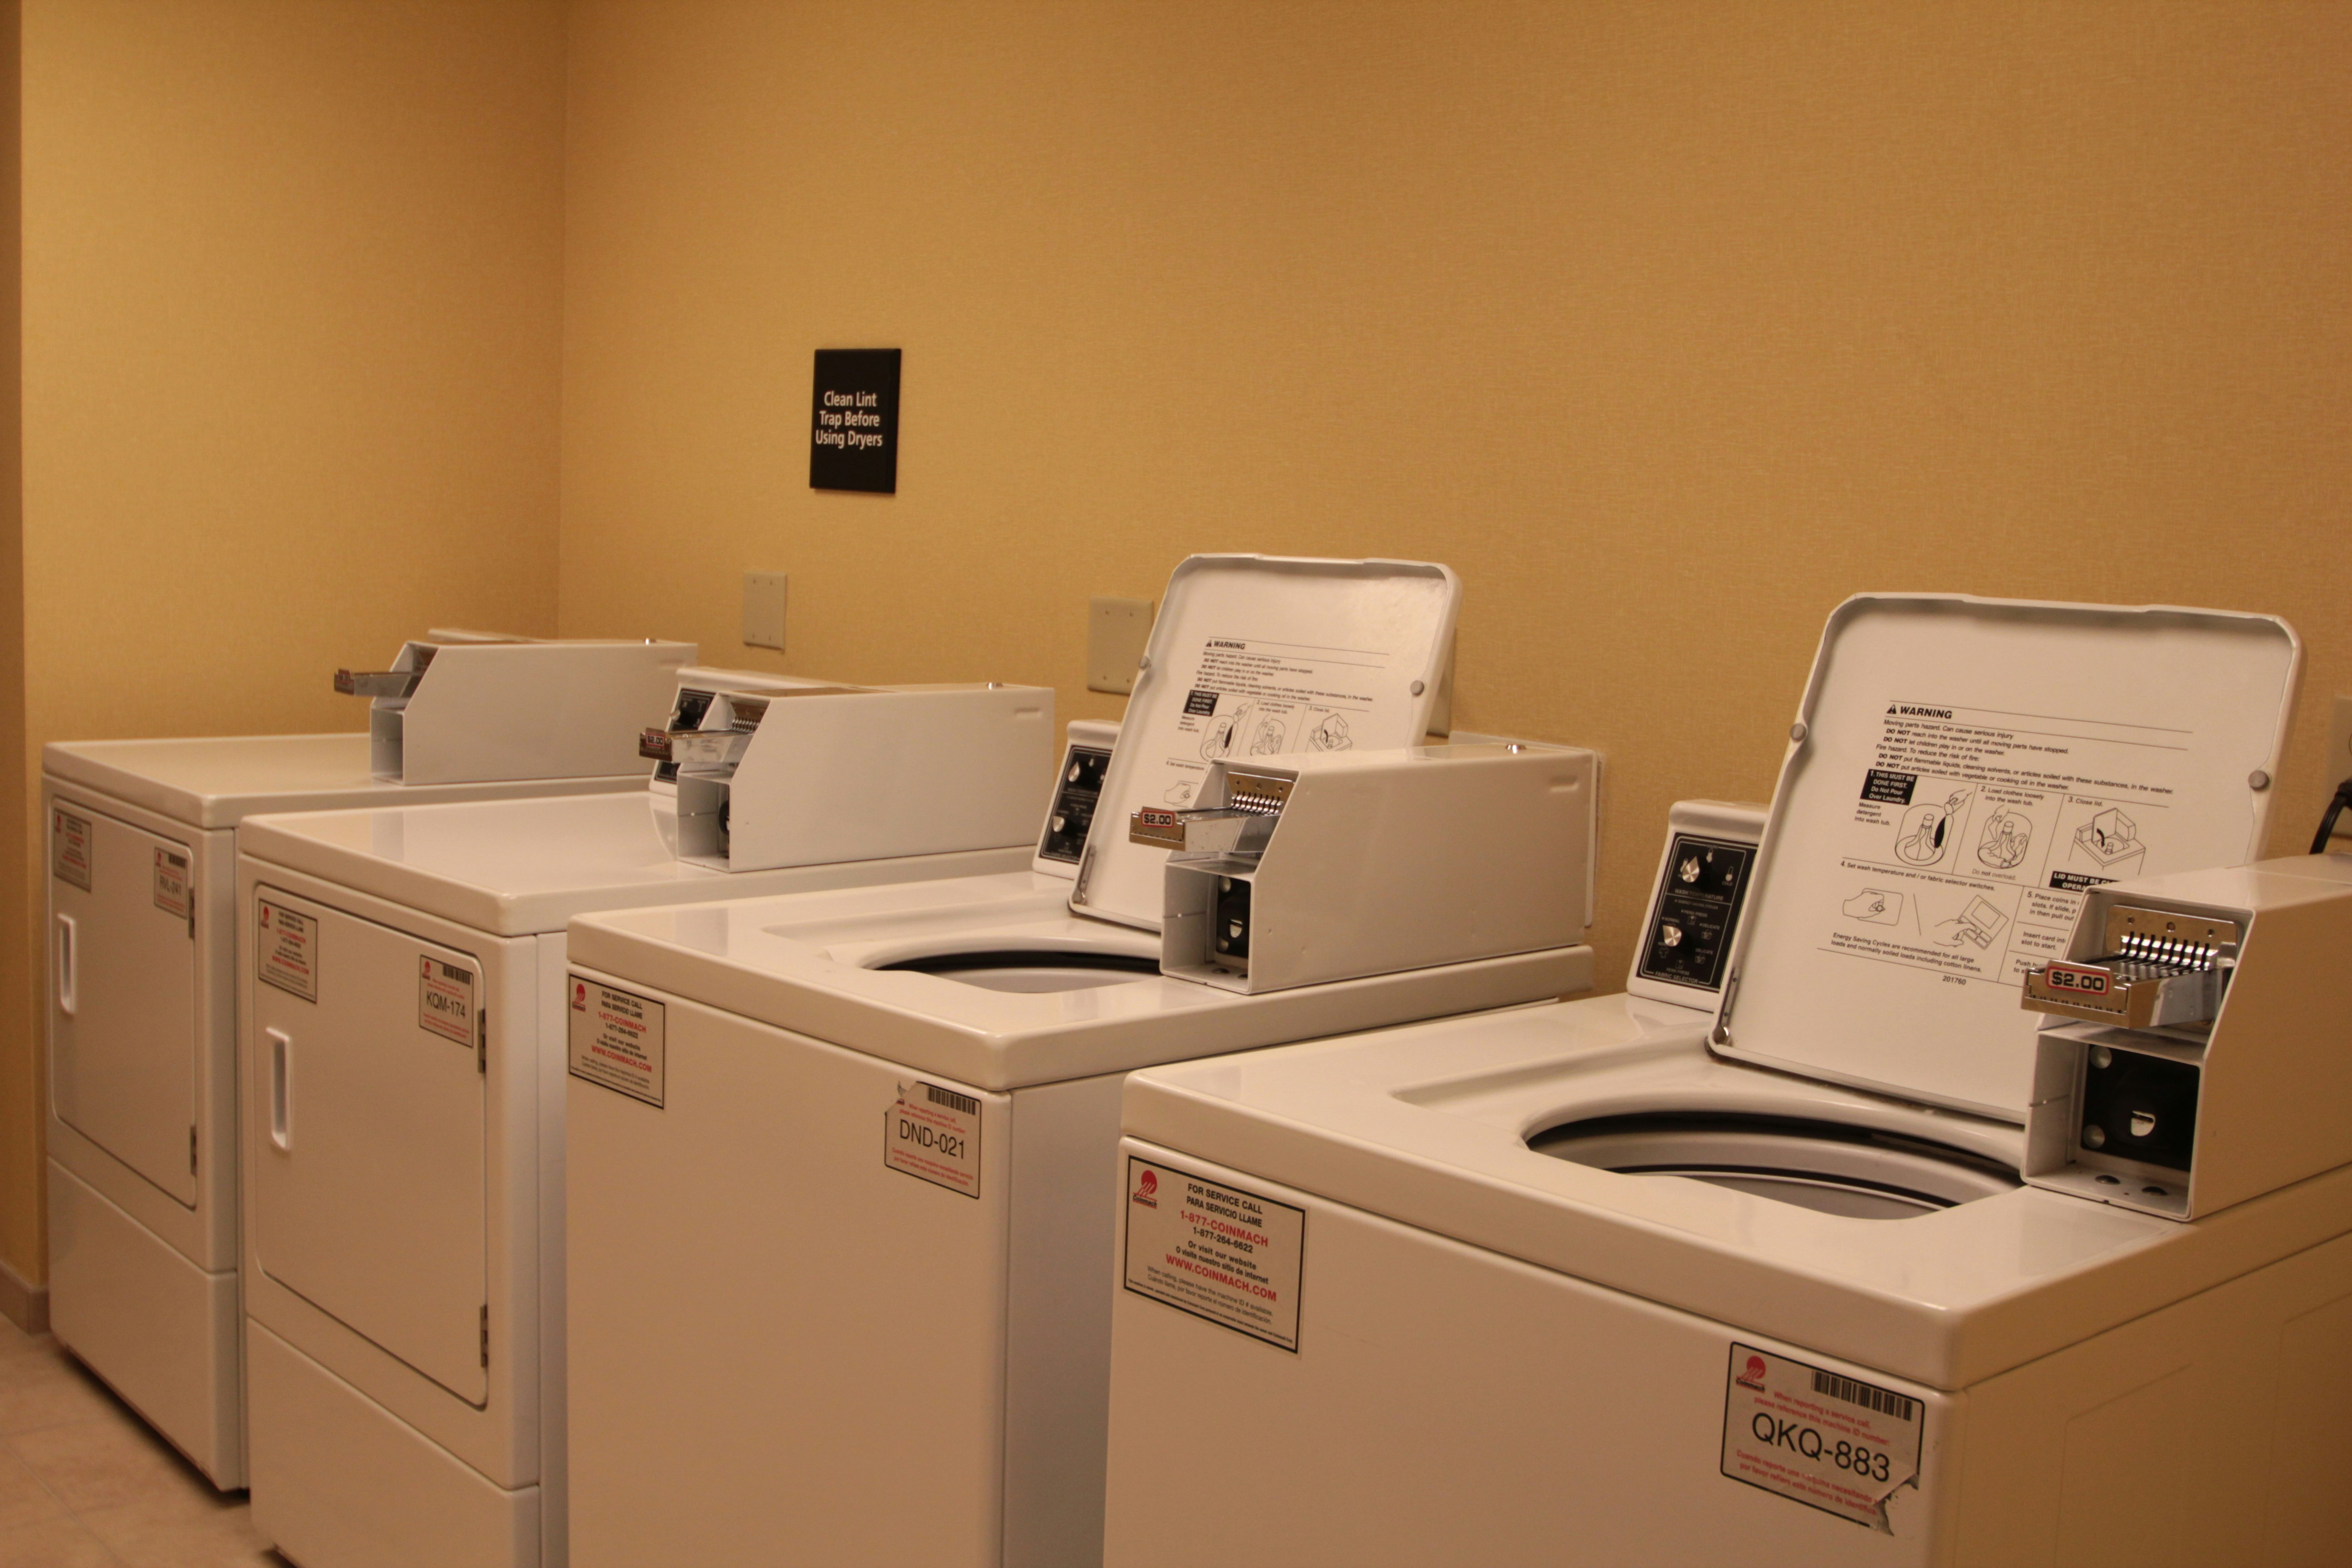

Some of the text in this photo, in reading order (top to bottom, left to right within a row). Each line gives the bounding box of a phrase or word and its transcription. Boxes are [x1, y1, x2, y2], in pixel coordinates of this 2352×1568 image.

[824, 390, 877, 407] Clean Lint
[819, 411, 880, 429] Trap Before
[816, 429, 882, 450] Using Dryers
[1214, 641, 1245, 650] WARNING
[1900, 706, 1952, 719] WARNING
[1883, 719, 1904, 728] Moving
[1914, 757, 1941, 765] flammable
[1962, 764, 1985, 772] cleaning
[2024, 792, 2044, 800] loosely
[1144, 813, 1171, 825] $2.00
[2067, 874, 2089, 882] MUST
[2089, 876, 2100, 885] BE
[2034, 893, 2051, 901] Place
[1833, 932, 1852, 941] Energy
[1852, 936, 1871, 945] Saving
[1901, 946, 1941, 957] recommended
[1960, 956, 1974, 964] large
[1673, 975, 1698, 984] SELECTOR
[1942, 975, 1966, 985] 201760
[2052, 971, 2104, 991] $2.00
[426, 991, 466, 1018] KQM-174
[602, 990, 642, 1009] FOR SERVICE CALL
[598, 1011, 646, 1033] 1-877-COINMACH
[591, 1045, 652, 1073] WWW.COINMACH.COM
[900, 1119, 964, 1159] DND-021
[1188, 1183, 1262, 1215] FOR SERVICE CALL
[1186, 1196, 1262, 1228] PARA SERVICIO LLAME
[1180, 1210, 1268, 1247] 1-877-COINMACH
[1193, 1226, 1253, 1254] 1-877-264-6622
[1188, 1240, 1256, 1270] Or visit our website
[1182, 1249, 1197, 1259] visite
[1198, 1255, 1220, 1268] nuestro
[1222, 1263, 1234, 1272] sitio
[1235, 1267, 1243, 1275] de
[1245, 1269, 1269, 1284] internet
[1166, 1254, 1276, 1302] WWW.COINMACH.COM
[1752, 1412, 1890, 1482] QKQ-883
